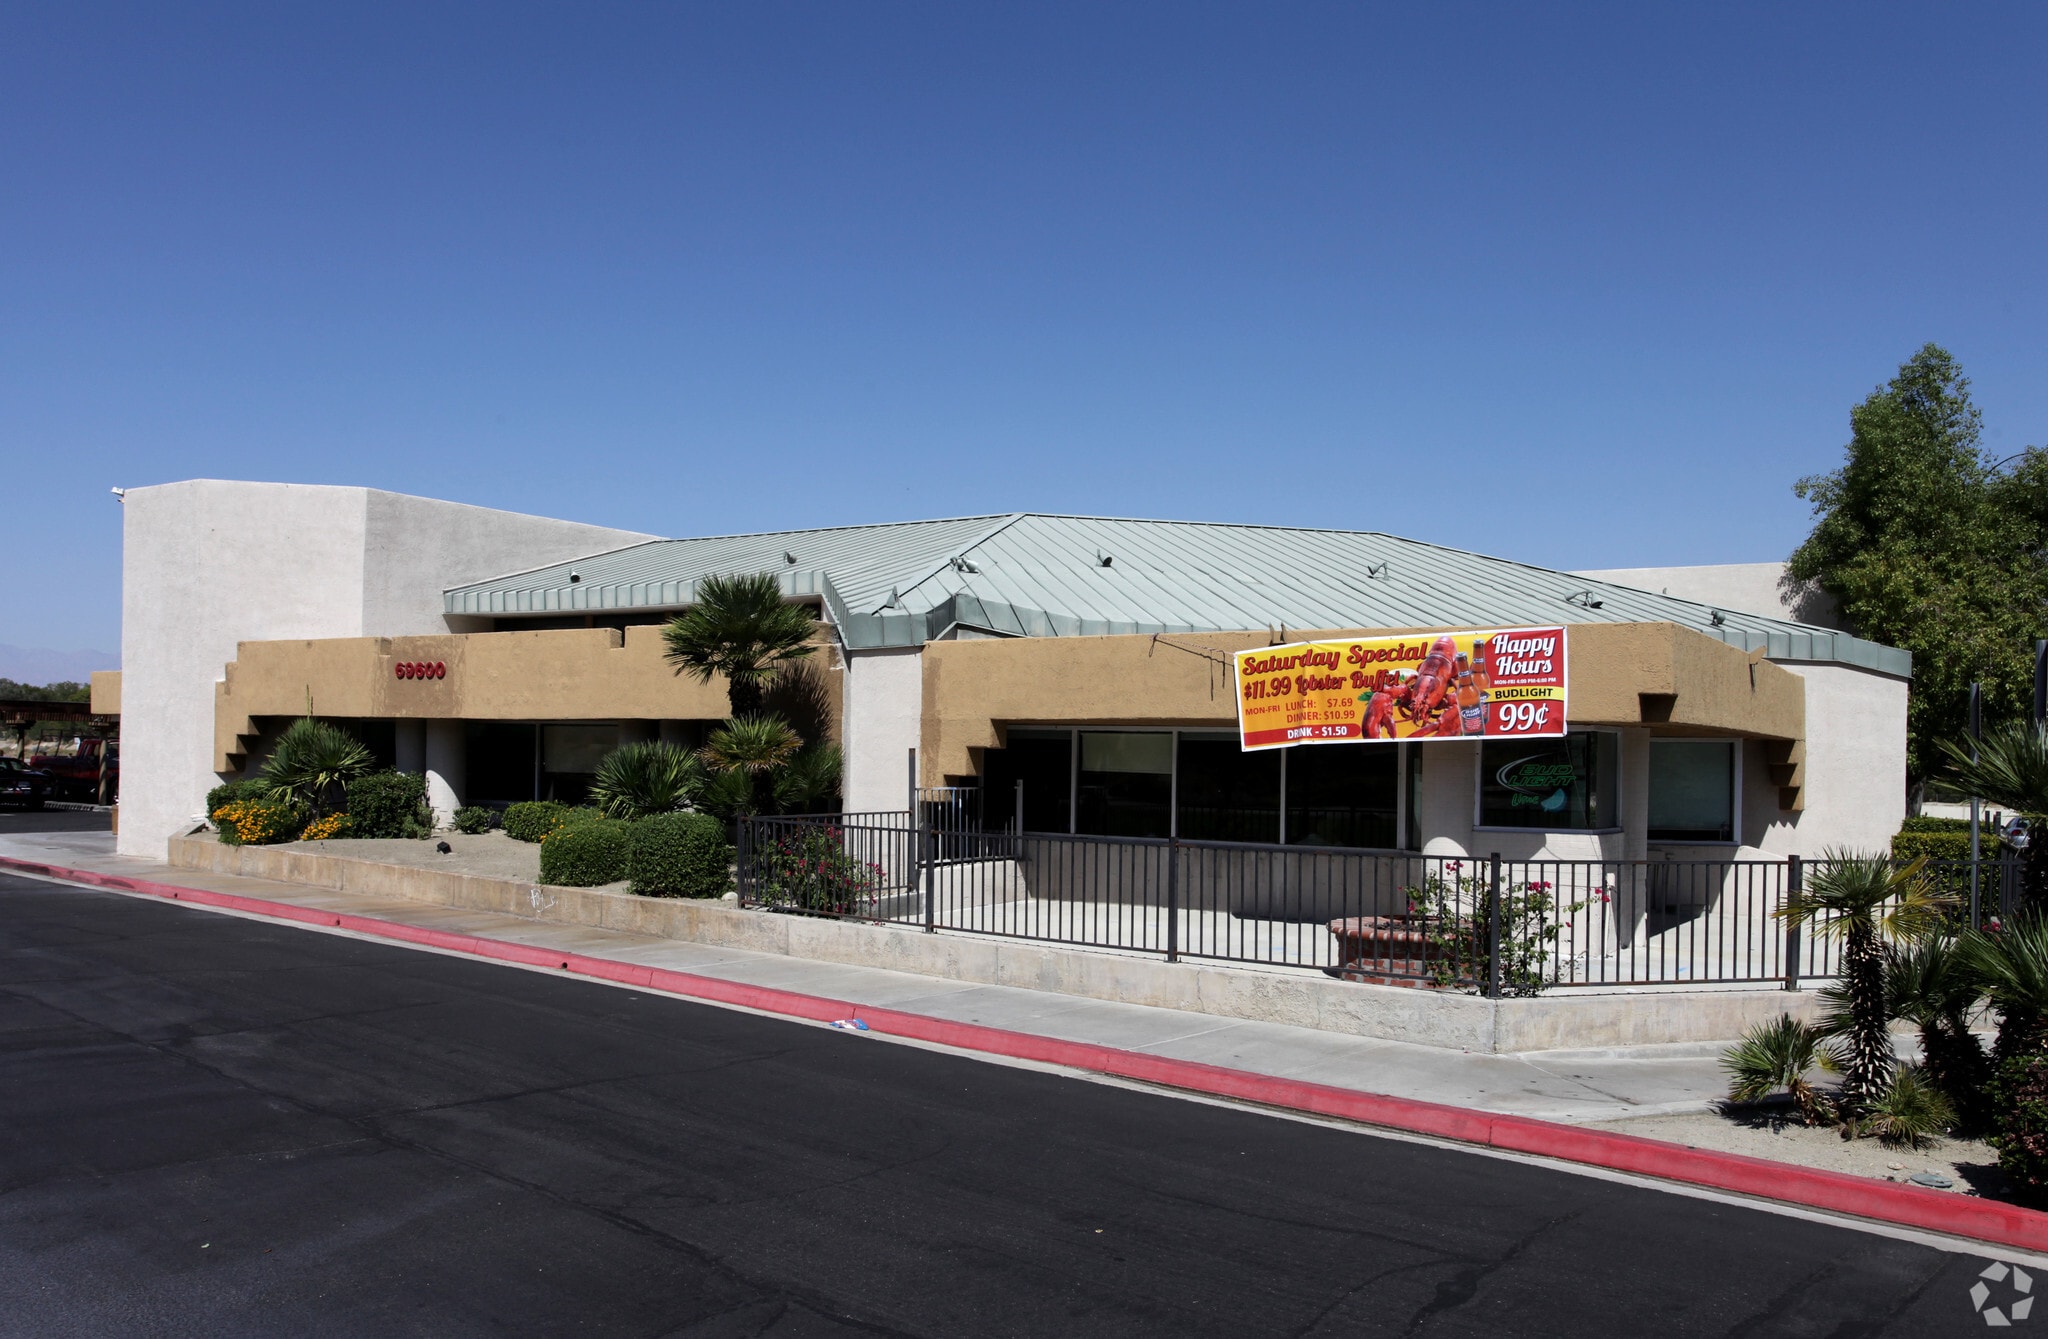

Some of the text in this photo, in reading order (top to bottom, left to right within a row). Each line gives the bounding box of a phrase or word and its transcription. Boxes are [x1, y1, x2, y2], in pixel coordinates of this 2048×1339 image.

[1492, 634, 1556, 657] Happy
[1242, 642, 1428, 675] Saturday Special
[1496, 656, 1553, 675] Hours
[395, 661, 446, 680] 69600
[1244, 669, 1401, 700] $11.99 Lobster Buffet
[1494, 688, 1553, 699] BUDLIGHT
[1245, 705, 1281, 716] MON-FRI
[1285, 698, 1353, 712] LUNCH: $7.69
[1286, 710, 1355, 724] DINNER: $10.99
[1499, 703, 1549, 731] 99¢
[1287, 727, 1313, 739] DRINK
[1321, 726, 1348, 737] $1.50
[1520, 764, 1573, 776] BUD
[1508, 775, 1577, 787] LIGHT
